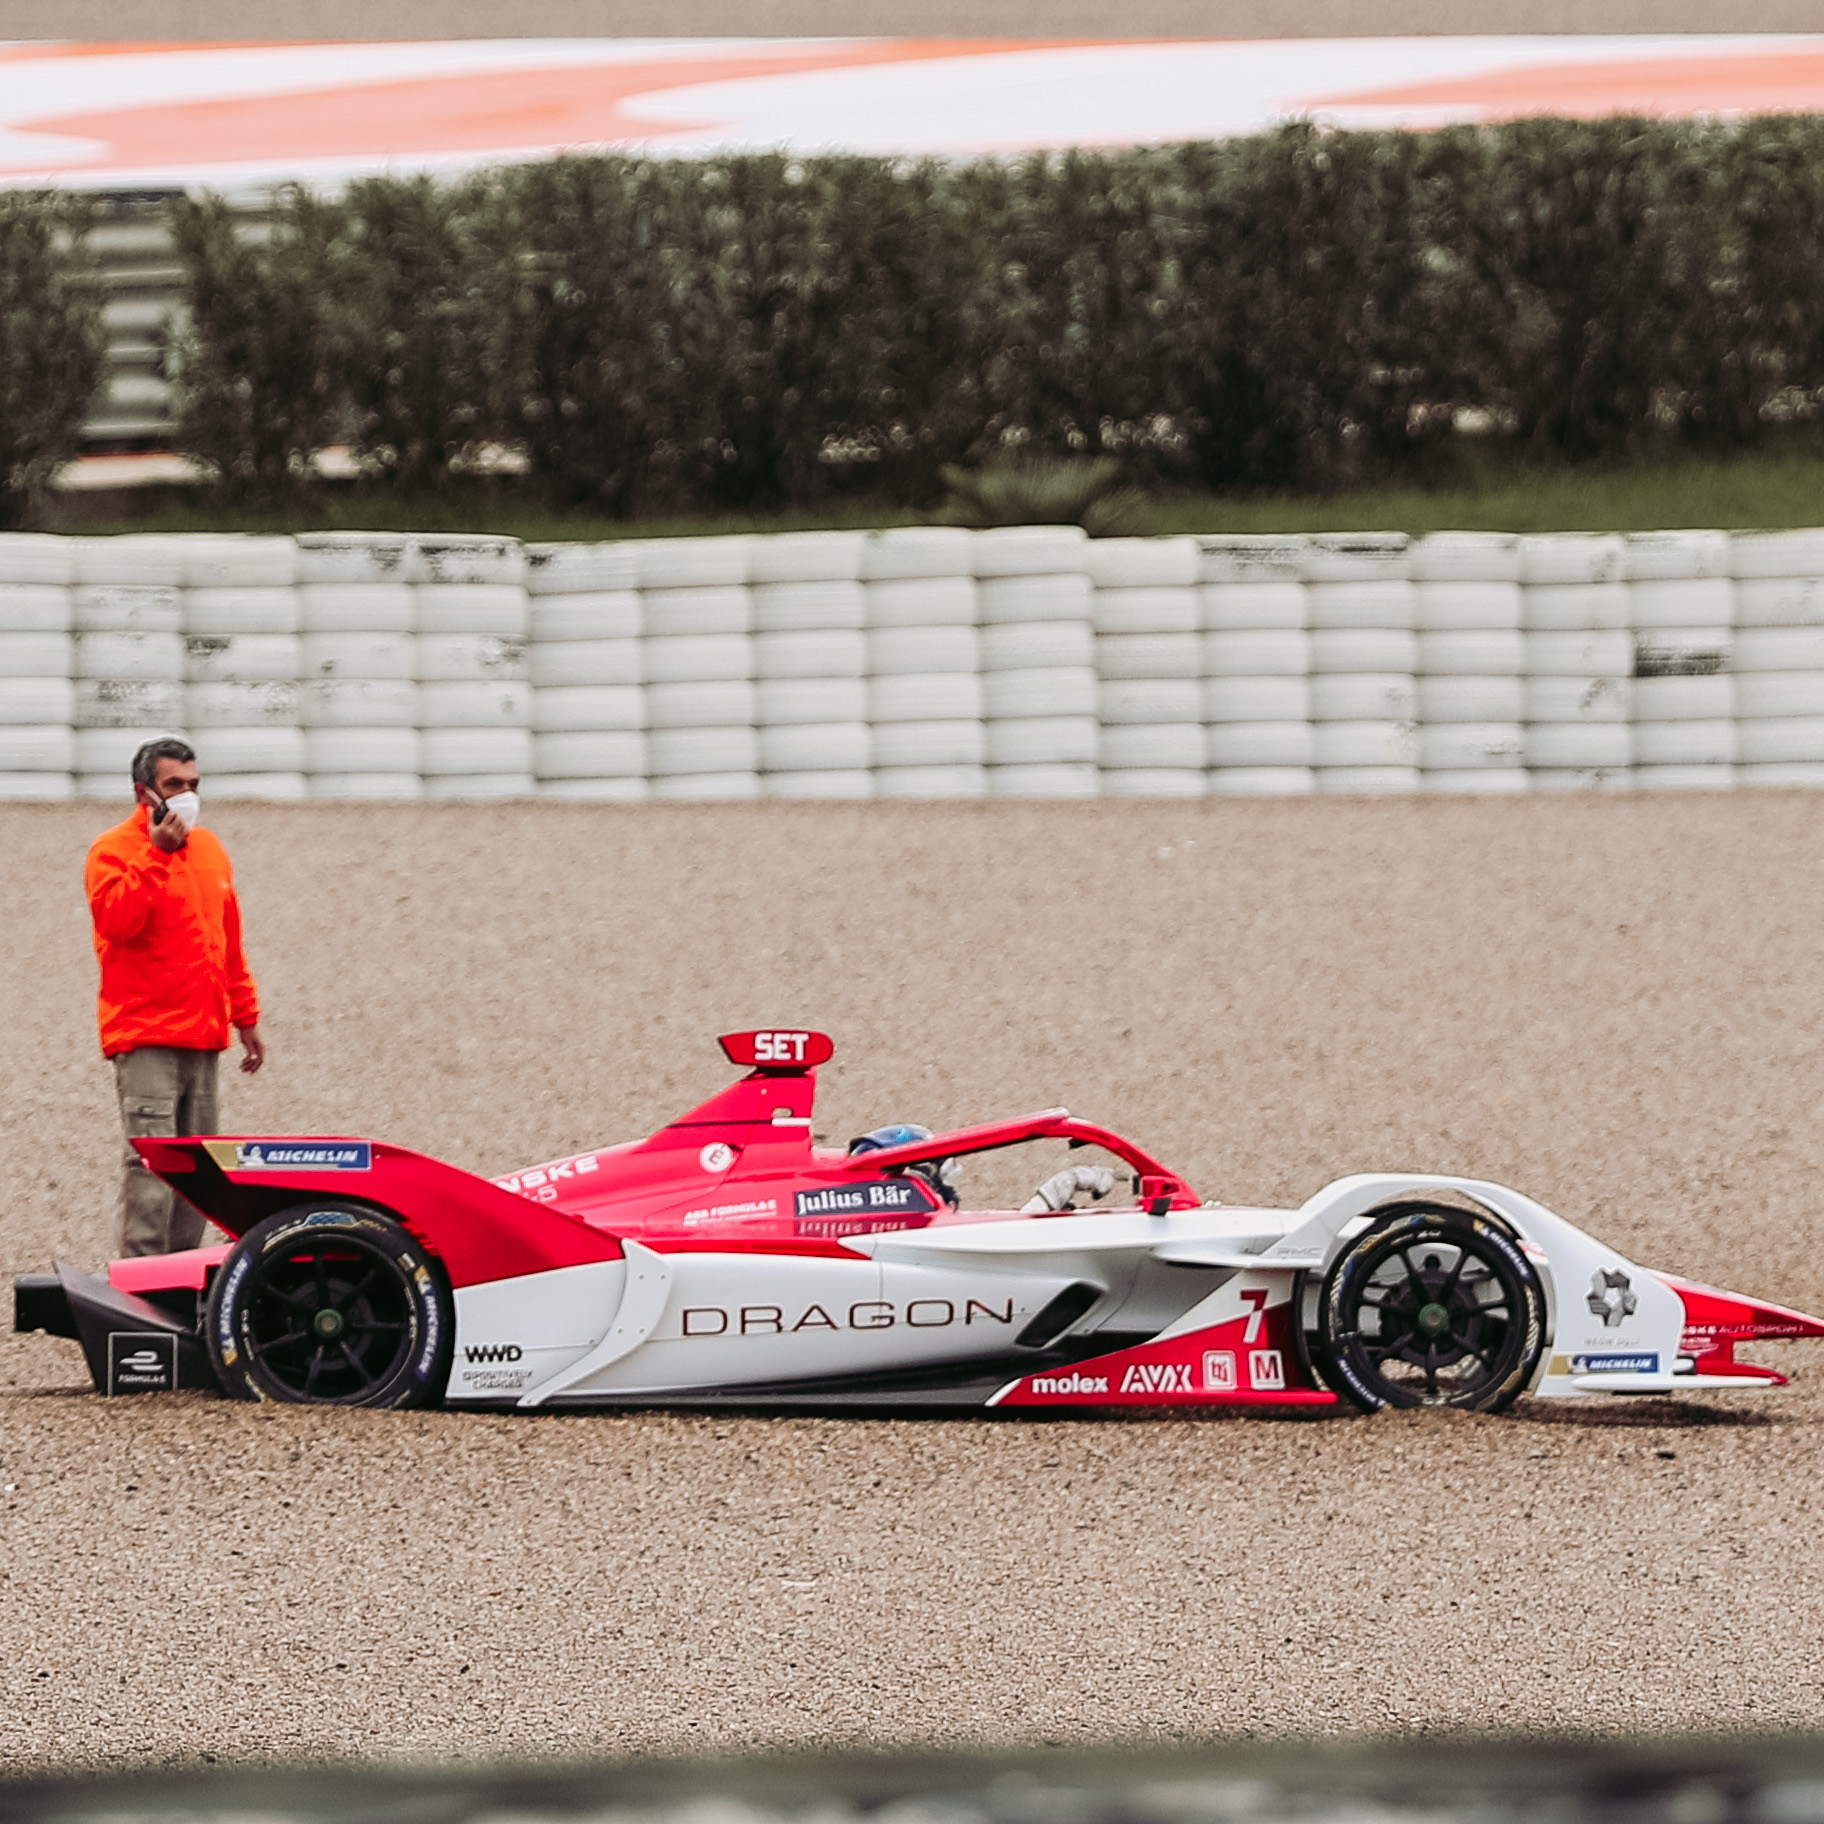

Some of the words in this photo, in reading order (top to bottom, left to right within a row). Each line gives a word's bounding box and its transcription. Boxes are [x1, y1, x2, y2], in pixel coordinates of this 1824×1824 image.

[754, 1033, 810, 1061] SET
[266, 1149, 359, 1163] MICHELIN
[797, 1189, 864, 1216] Julius
[869, 1184, 911, 1206] Bär
[681, 1297, 1014, 1337] DRAGON
[1240, 1289, 1269, 1344] 7
[465, 1345, 523, 1363] WWD
[1589, 1357, 1651, 1370] MICHELIN
[1032, 1372, 1108, 1394] molex
[1119, 1364, 1193, 1393] AVX
